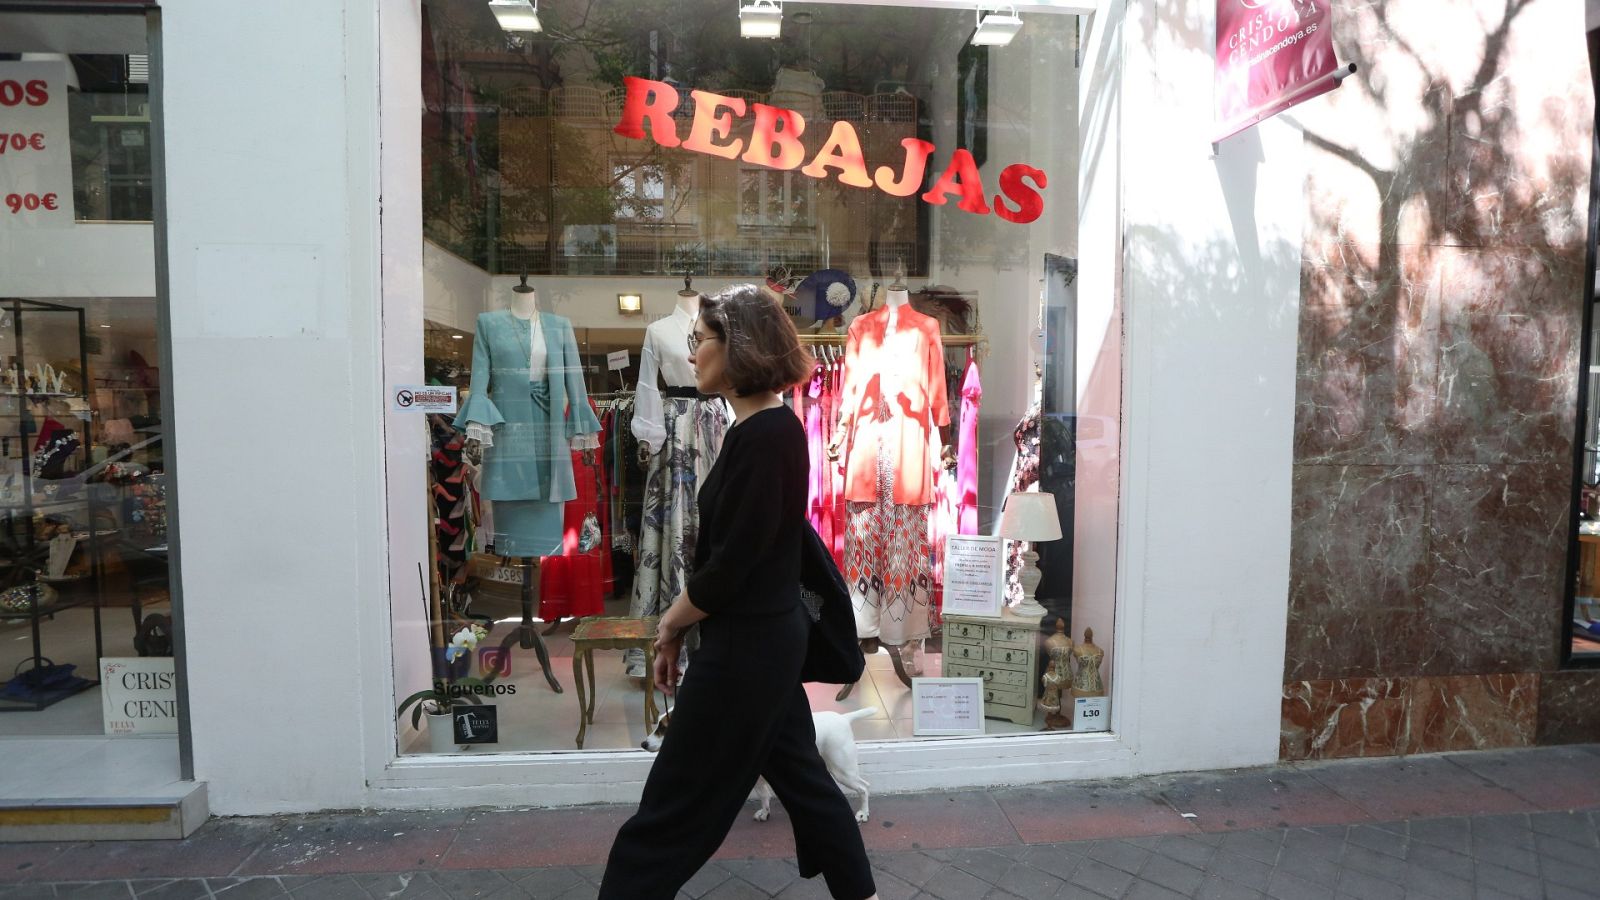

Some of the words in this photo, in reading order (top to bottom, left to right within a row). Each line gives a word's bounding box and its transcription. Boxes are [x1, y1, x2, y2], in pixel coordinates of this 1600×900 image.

[613, 75, 1048, 224] REBAJAS
[5, 192, 59, 214] 90€
[1083, 709, 1100, 718] L30
